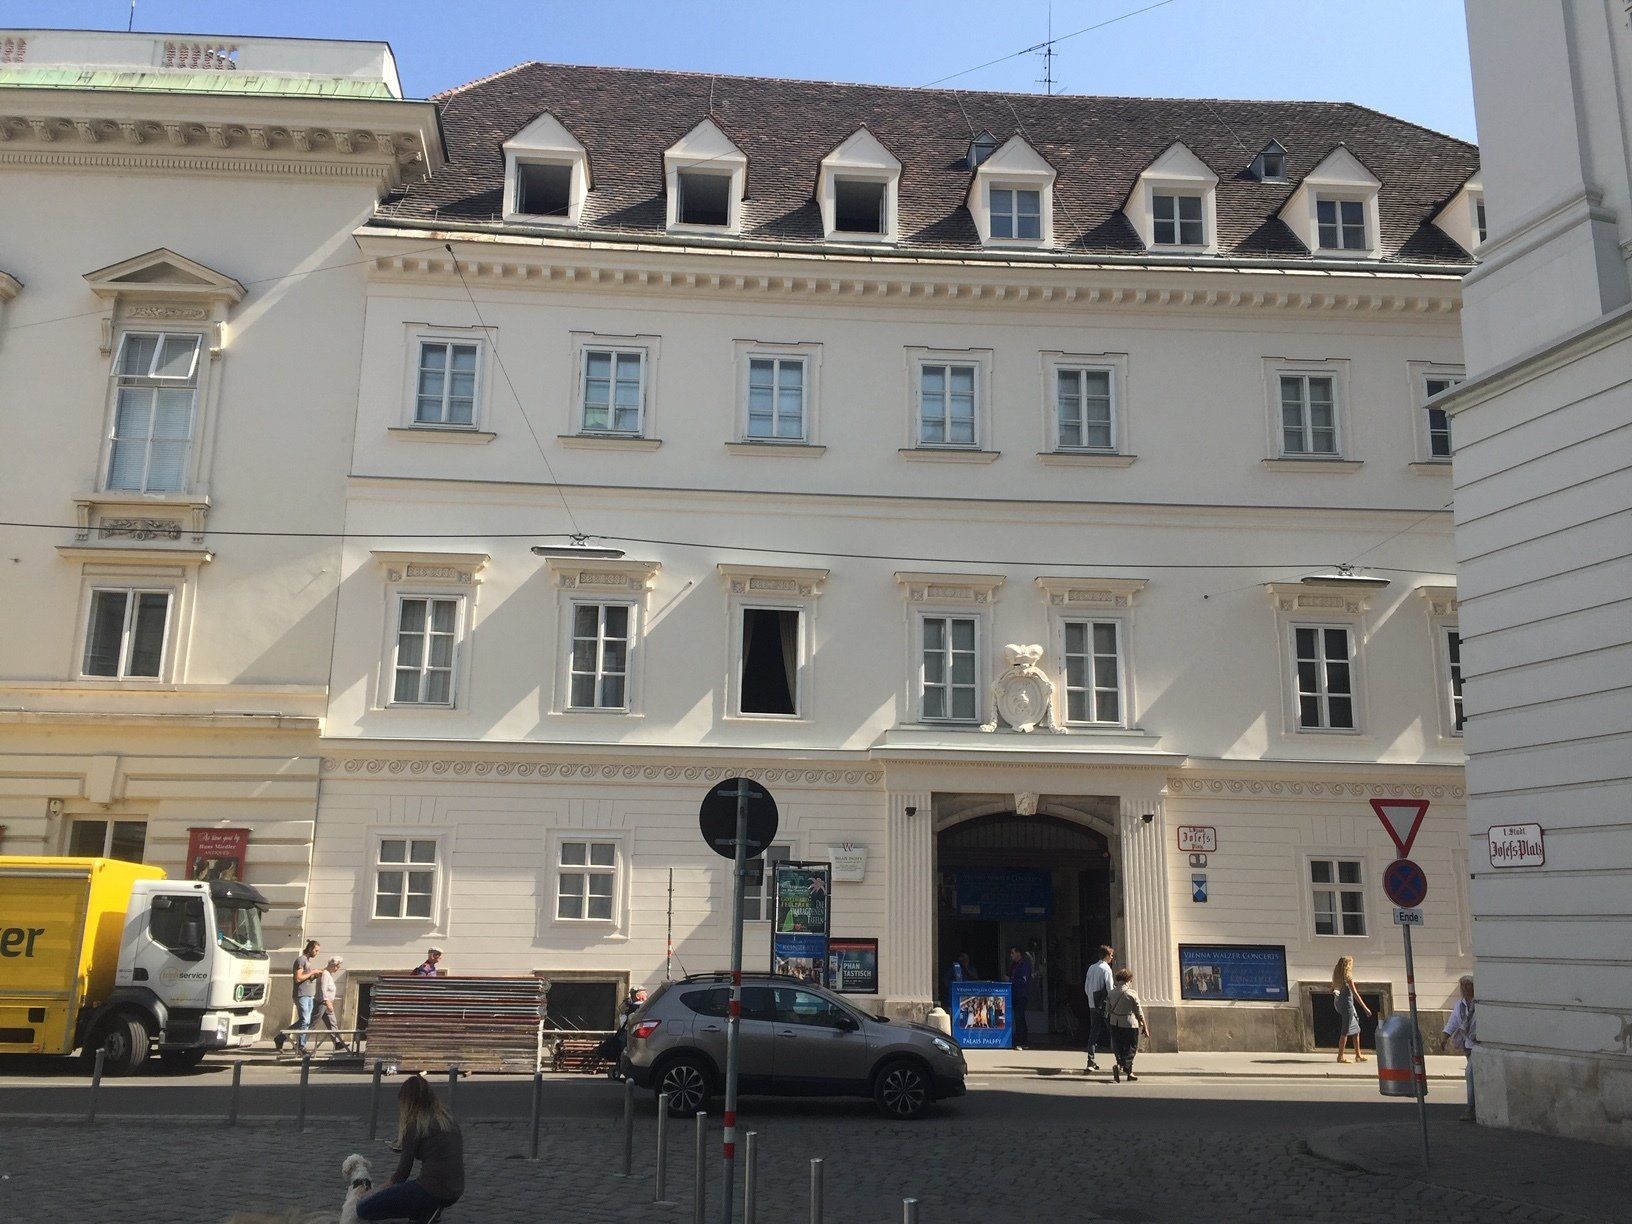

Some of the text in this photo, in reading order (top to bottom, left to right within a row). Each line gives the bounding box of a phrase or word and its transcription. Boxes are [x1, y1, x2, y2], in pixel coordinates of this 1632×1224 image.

[1400, 912, 1419, 922] Ende
[0, 928, 46, 958] er
[1184, 951, 1211, 959] VIENNA
[1242, 952, 1280, 961] CONCERTS
[843, 962, 861, 970] PHAN
[963, 1037, 982, 1045] PALAIS
